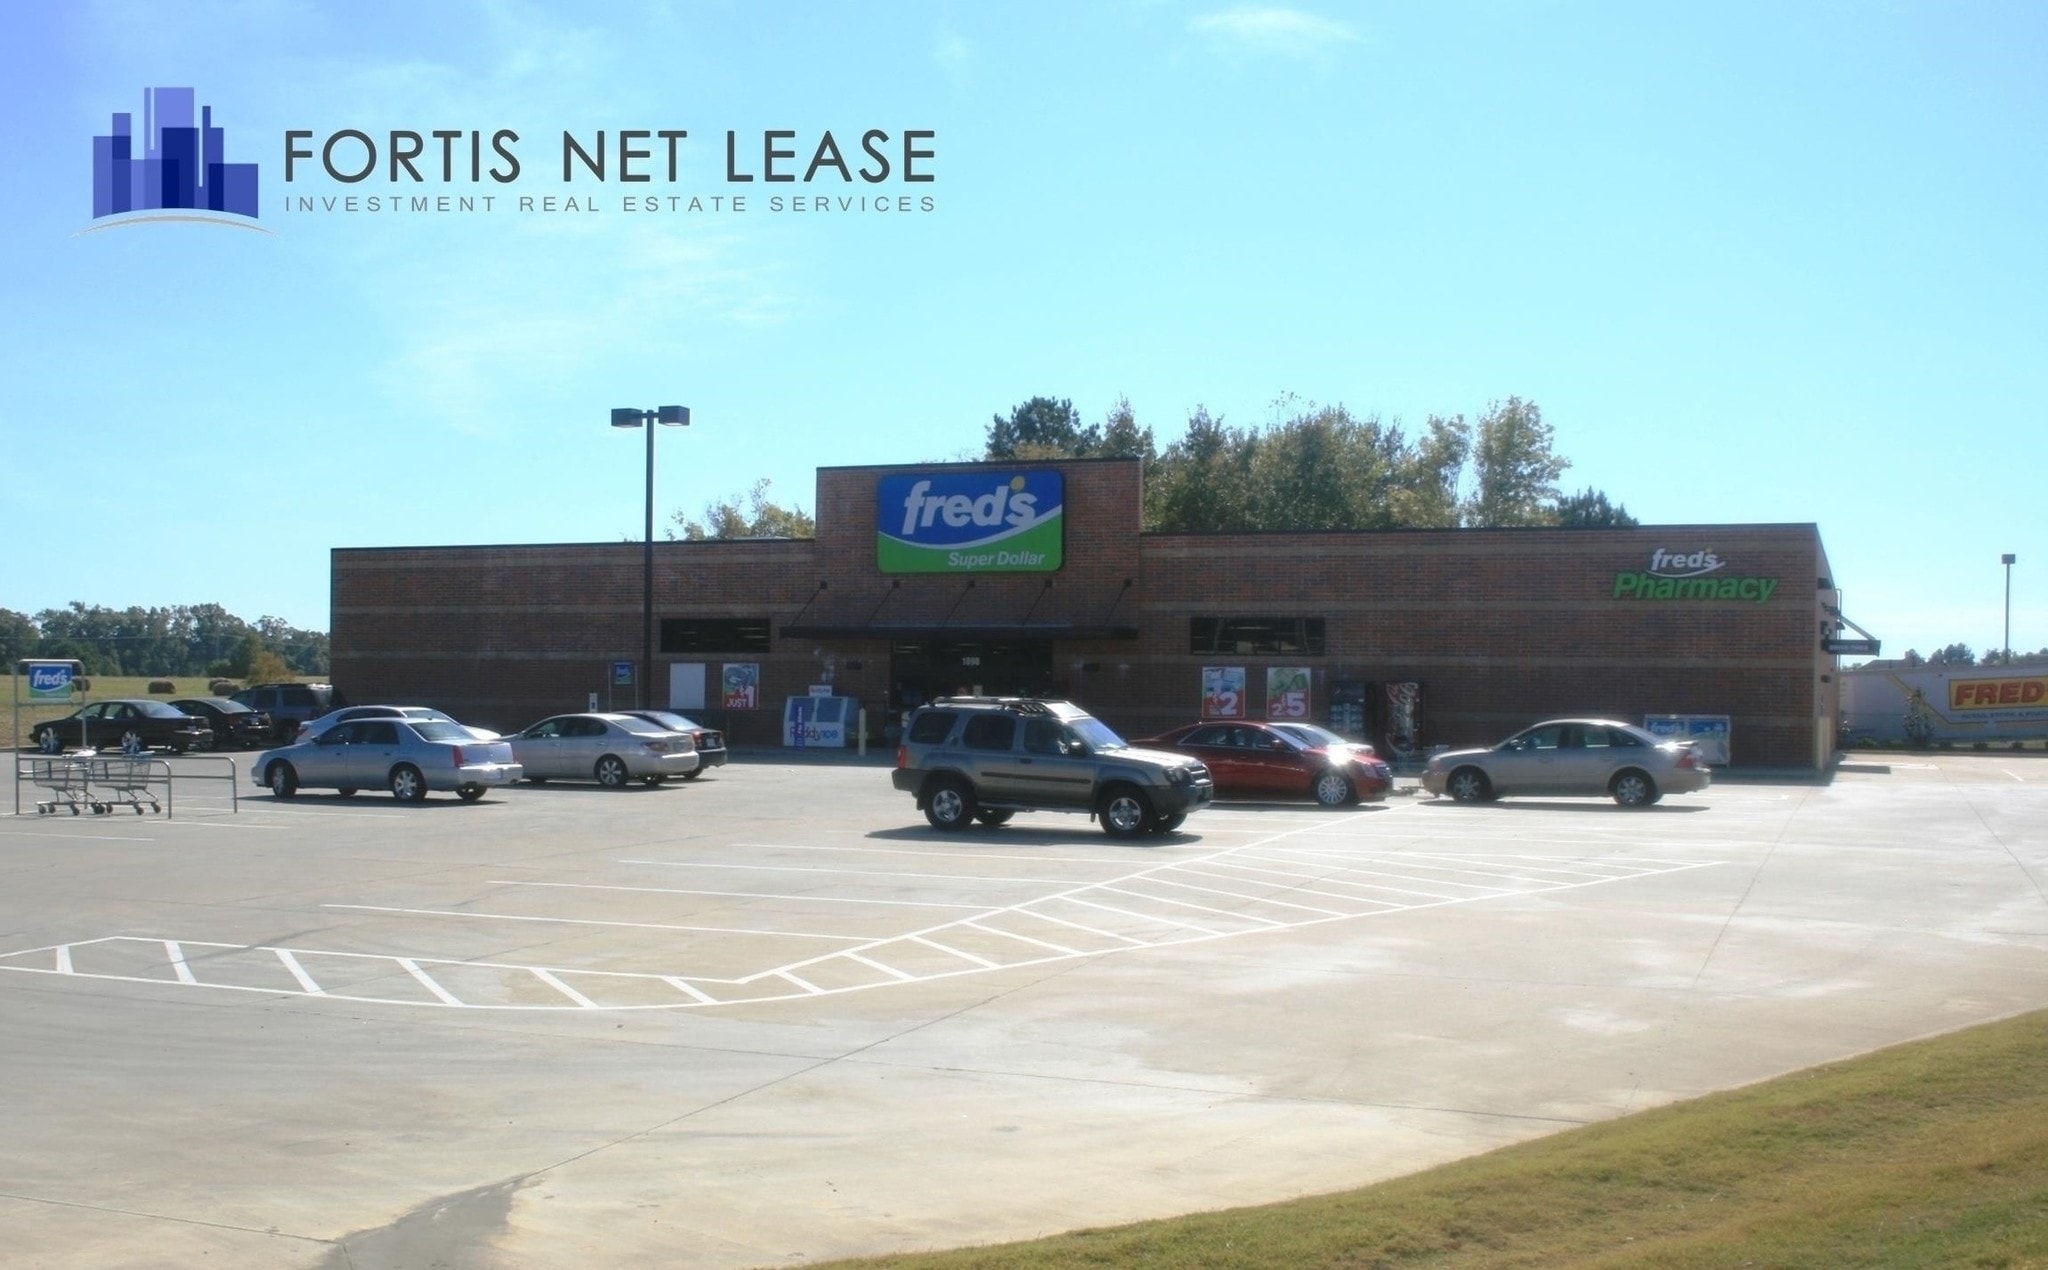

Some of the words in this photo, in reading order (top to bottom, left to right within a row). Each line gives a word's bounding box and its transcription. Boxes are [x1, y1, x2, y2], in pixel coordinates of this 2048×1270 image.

[902, 475, 1038, 535] fred's
[948, 551, 995, 569] Super
[997, 551, 1045, 566] Dollar
[1612, 571, 1779, 605] Pharmacy
[33, 669, 68, 687] fred's
